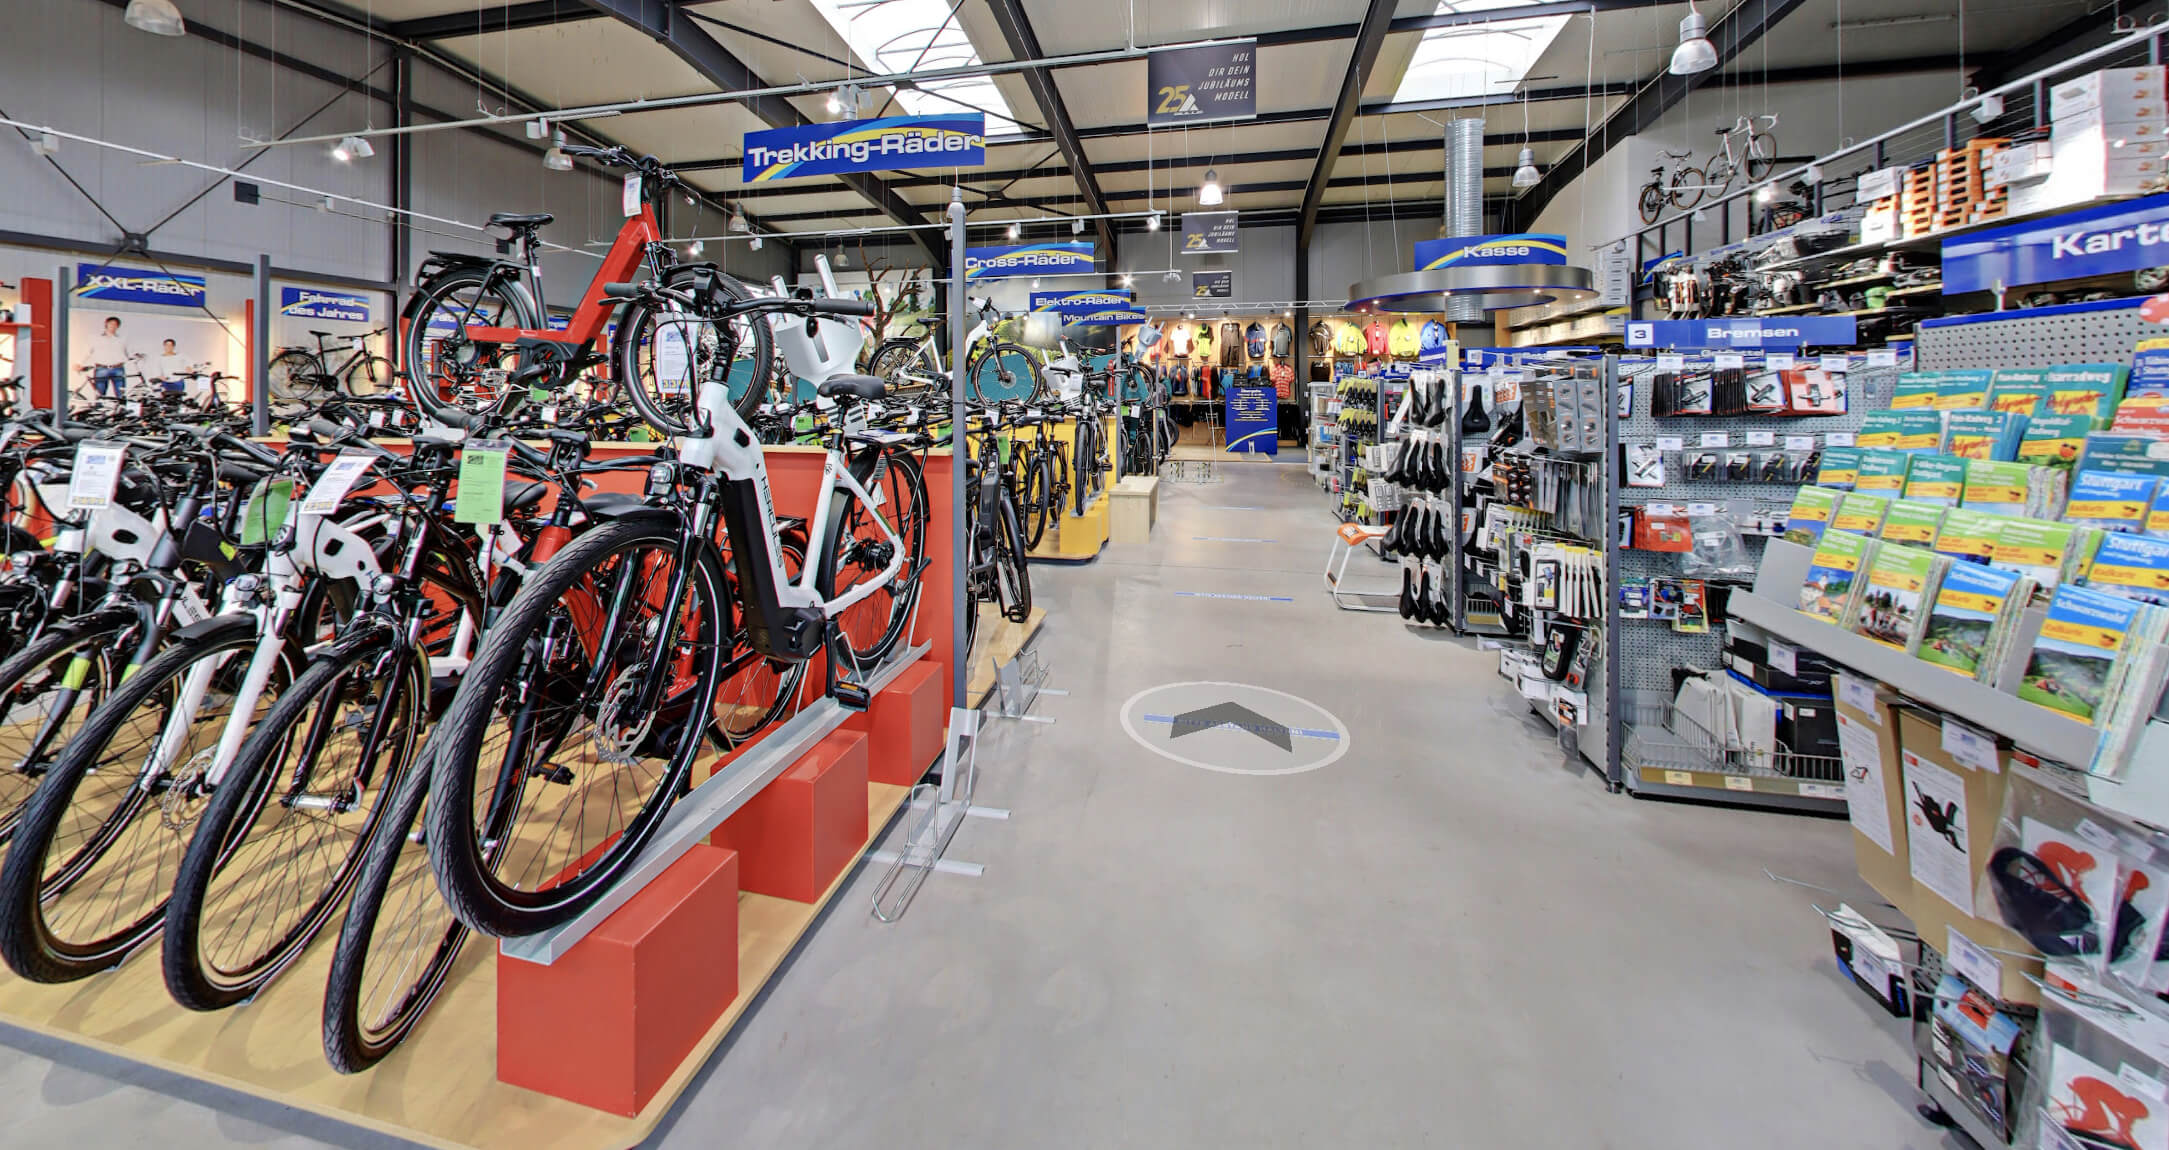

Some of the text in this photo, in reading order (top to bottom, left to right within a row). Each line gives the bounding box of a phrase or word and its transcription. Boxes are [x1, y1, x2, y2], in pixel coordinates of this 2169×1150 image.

[1227, 64, 1251, 76] DEIN
[1155, 84, 1191, 114] 25
[747, 130, 983, 168] Trekking-Räder
[1185, 232, 1205, 249] 25
[1463, 245, 1530, 259] Kasse
[965, 253, 1081, 270] Cross-Räder
[87, 273, 202, 298] XXL-Räder
[299, 290, 357, 308] Fahrrad
[1035, 295, 1125, 307] Elektro-Räder
[288, 305, 365, 322] des Jahres
[1063, 312, 1145, 322] Mountain Bikes
[1634, 327, 1800, 339] 3 Bremsen
[760, 475, 784, 569] HERCULES
